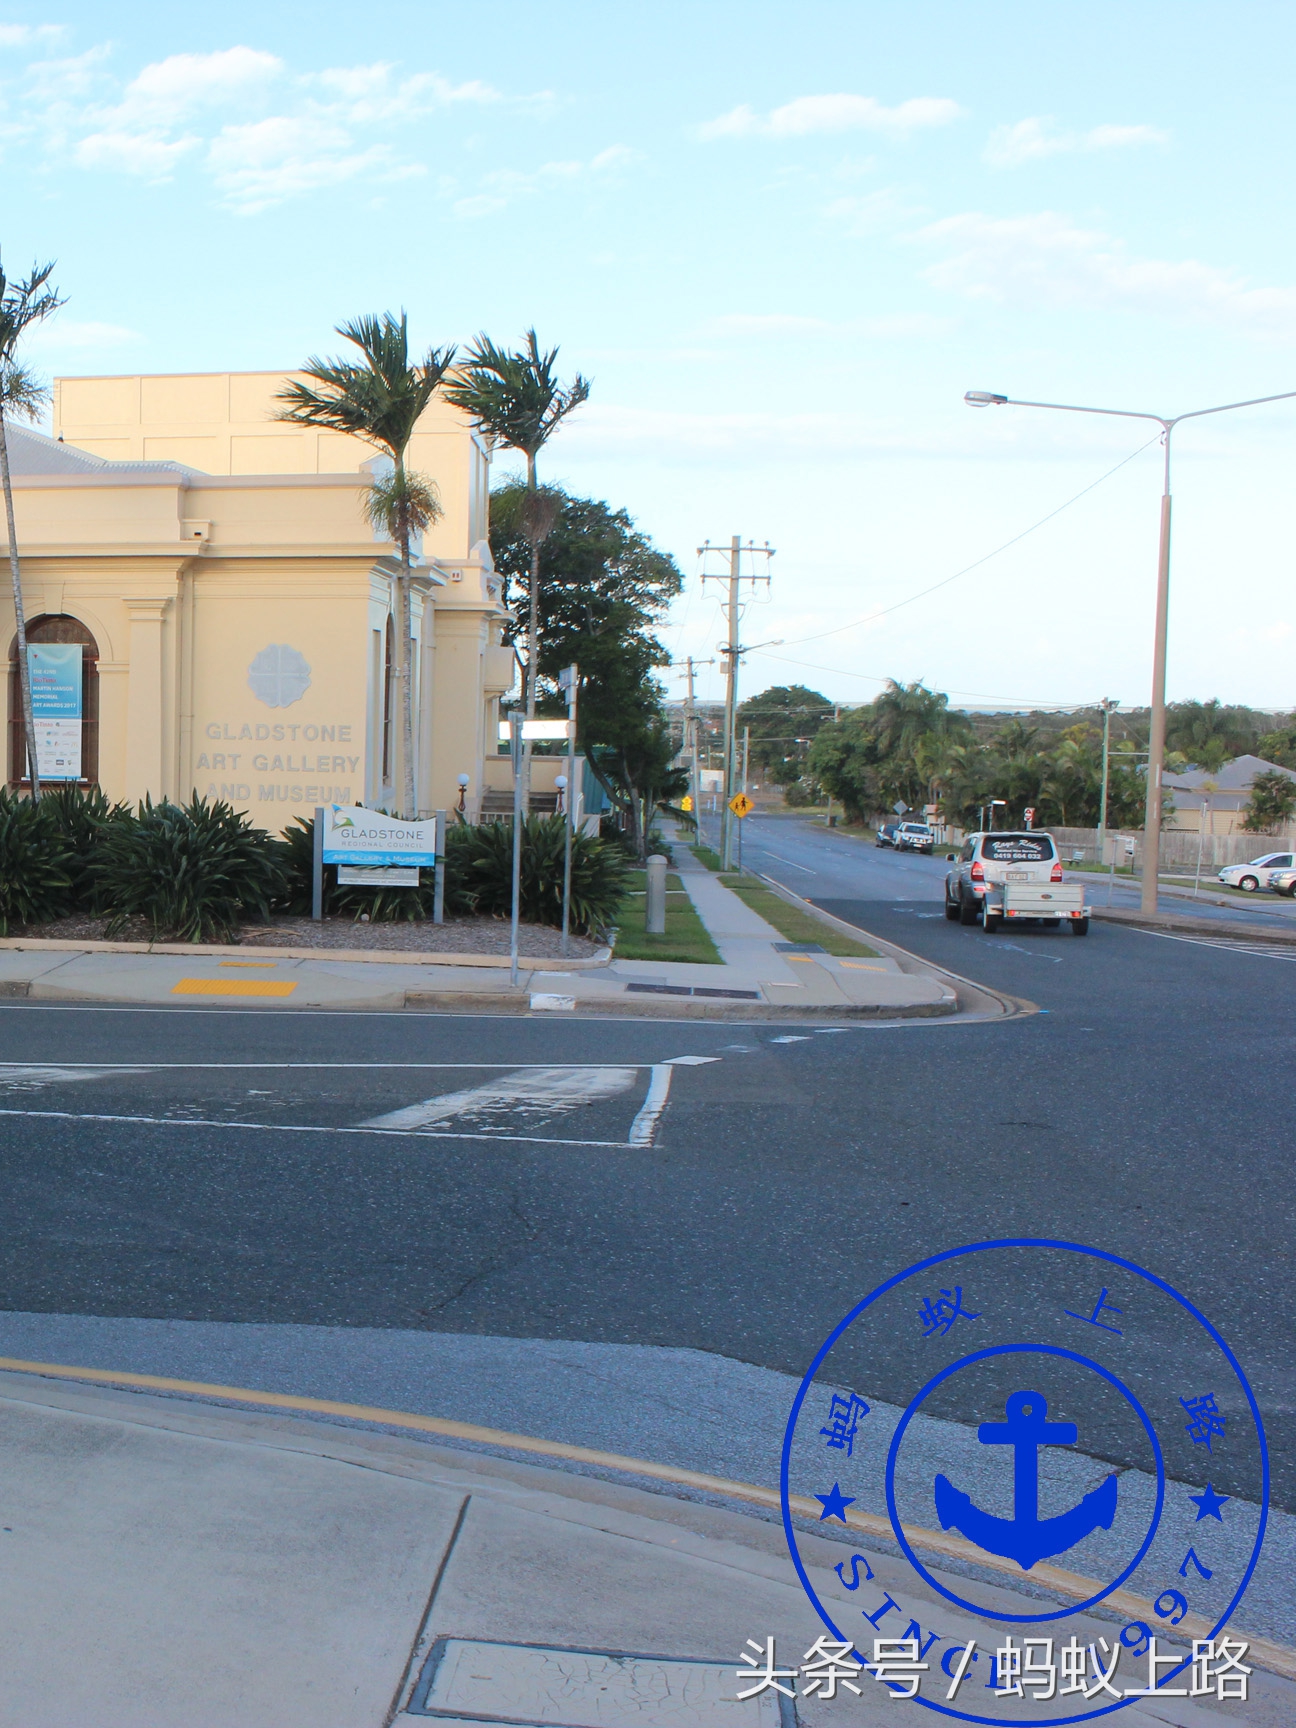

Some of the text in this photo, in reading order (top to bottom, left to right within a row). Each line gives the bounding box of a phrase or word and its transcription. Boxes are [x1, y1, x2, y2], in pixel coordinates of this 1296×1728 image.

[205, 722, 352, 743] GLADSTONE
[196, 753, 360, 774] ART GALLERY
[206, 783, 352, 804] AND MUSEUM
[341, 829, 424, 840] GLADSTONE
